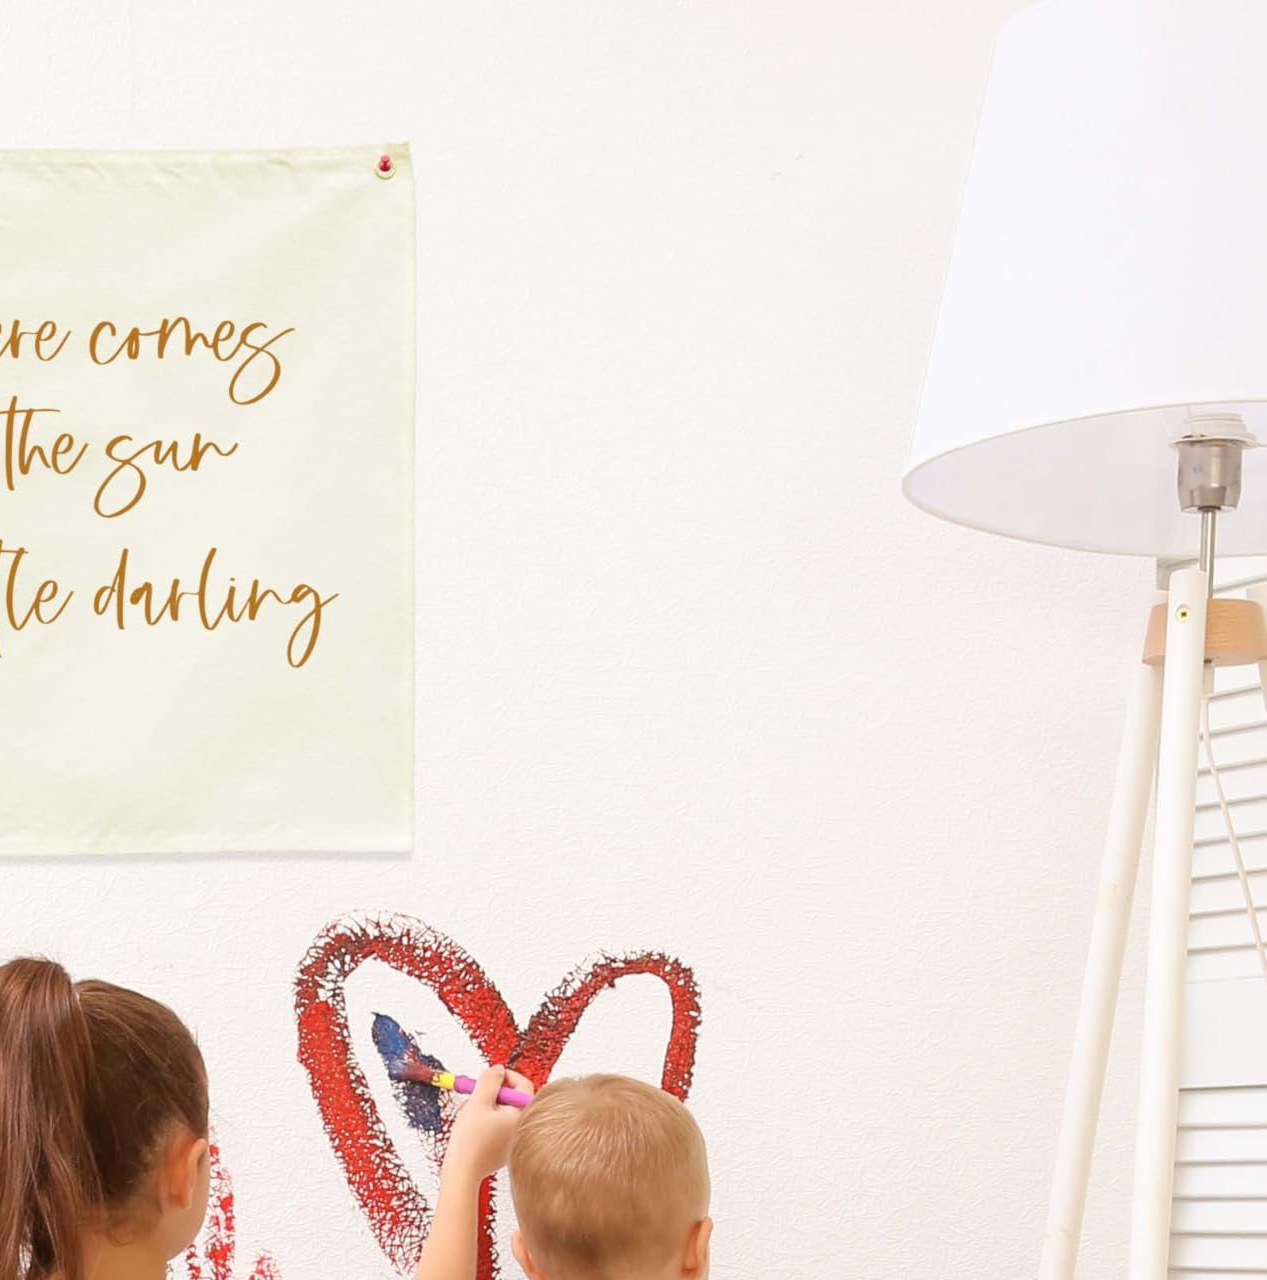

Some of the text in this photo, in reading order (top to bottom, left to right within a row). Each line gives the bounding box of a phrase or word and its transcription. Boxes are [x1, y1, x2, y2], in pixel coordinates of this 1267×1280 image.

[89, 316, 296, 406] comes
[93, 432, 239, 519] sun
[93, 547, 340, 669] darling
